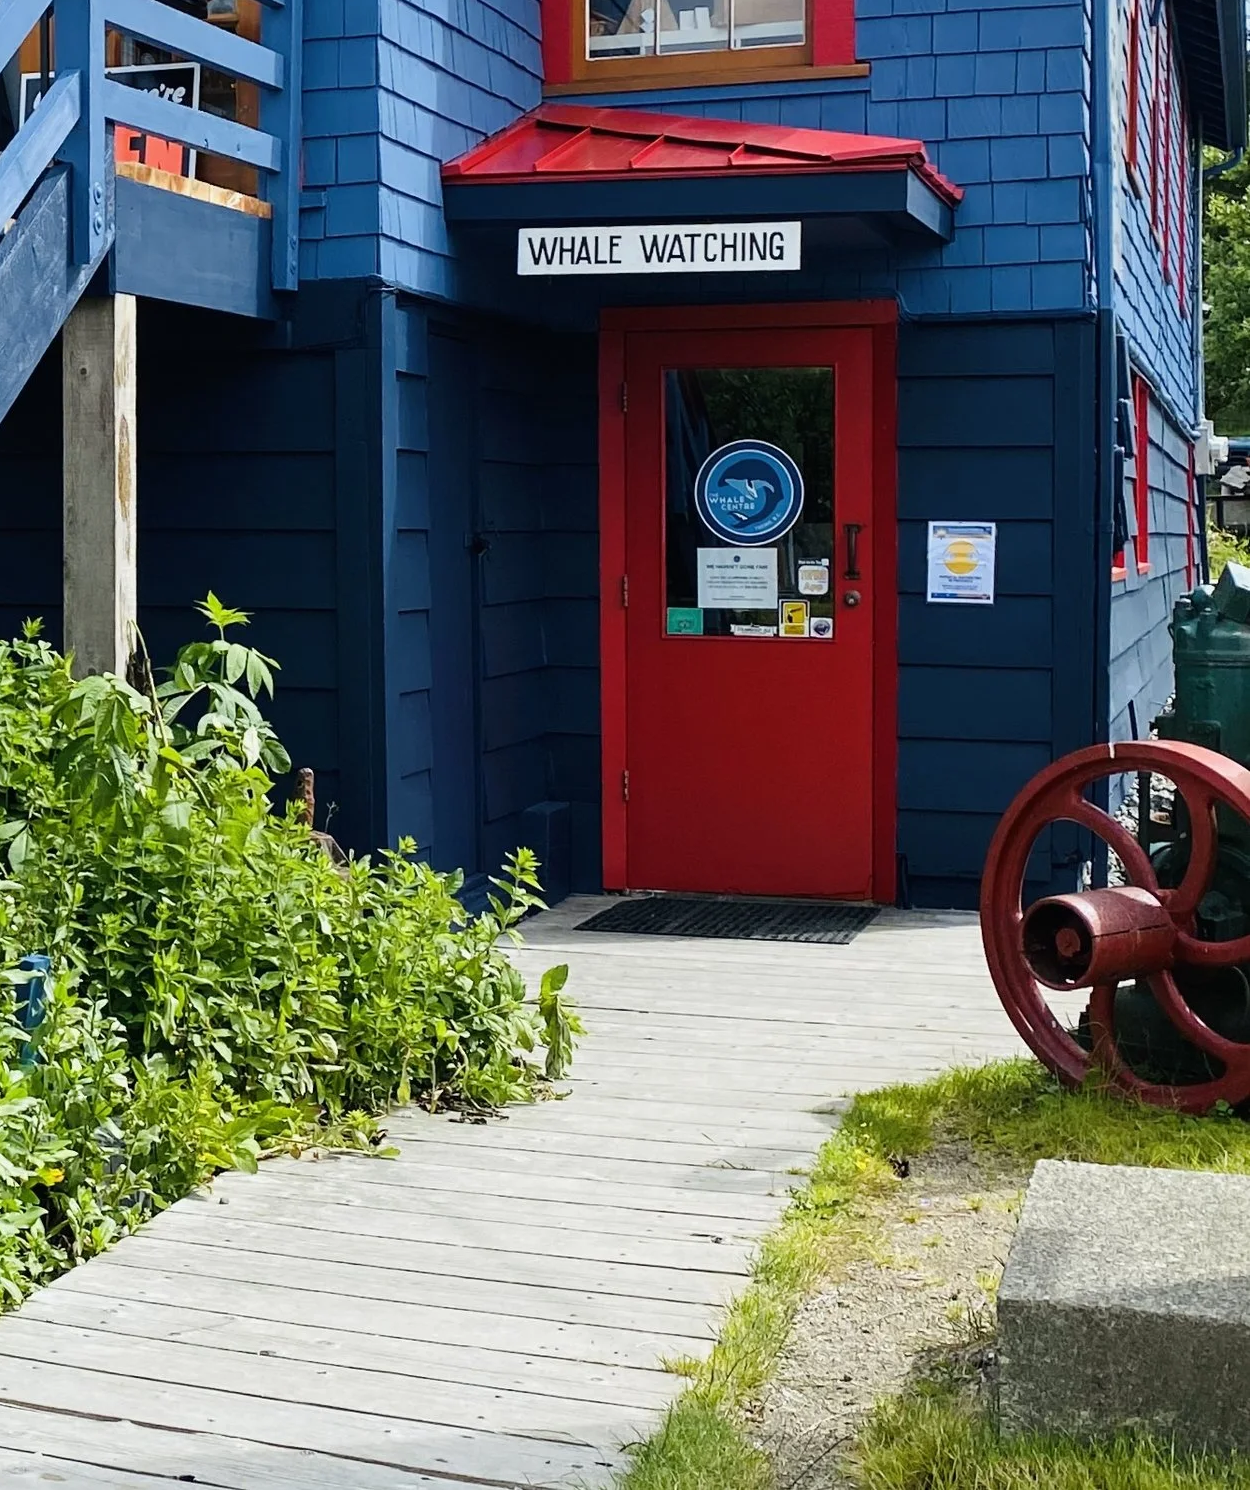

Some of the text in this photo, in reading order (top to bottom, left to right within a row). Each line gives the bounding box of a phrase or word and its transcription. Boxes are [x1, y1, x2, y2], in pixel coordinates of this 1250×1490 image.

[527, 231, 785, 266] WHALE WATCHING
[709, 496, 745, 505] WHALE
[721, 502, 756, 511] CENTRE
